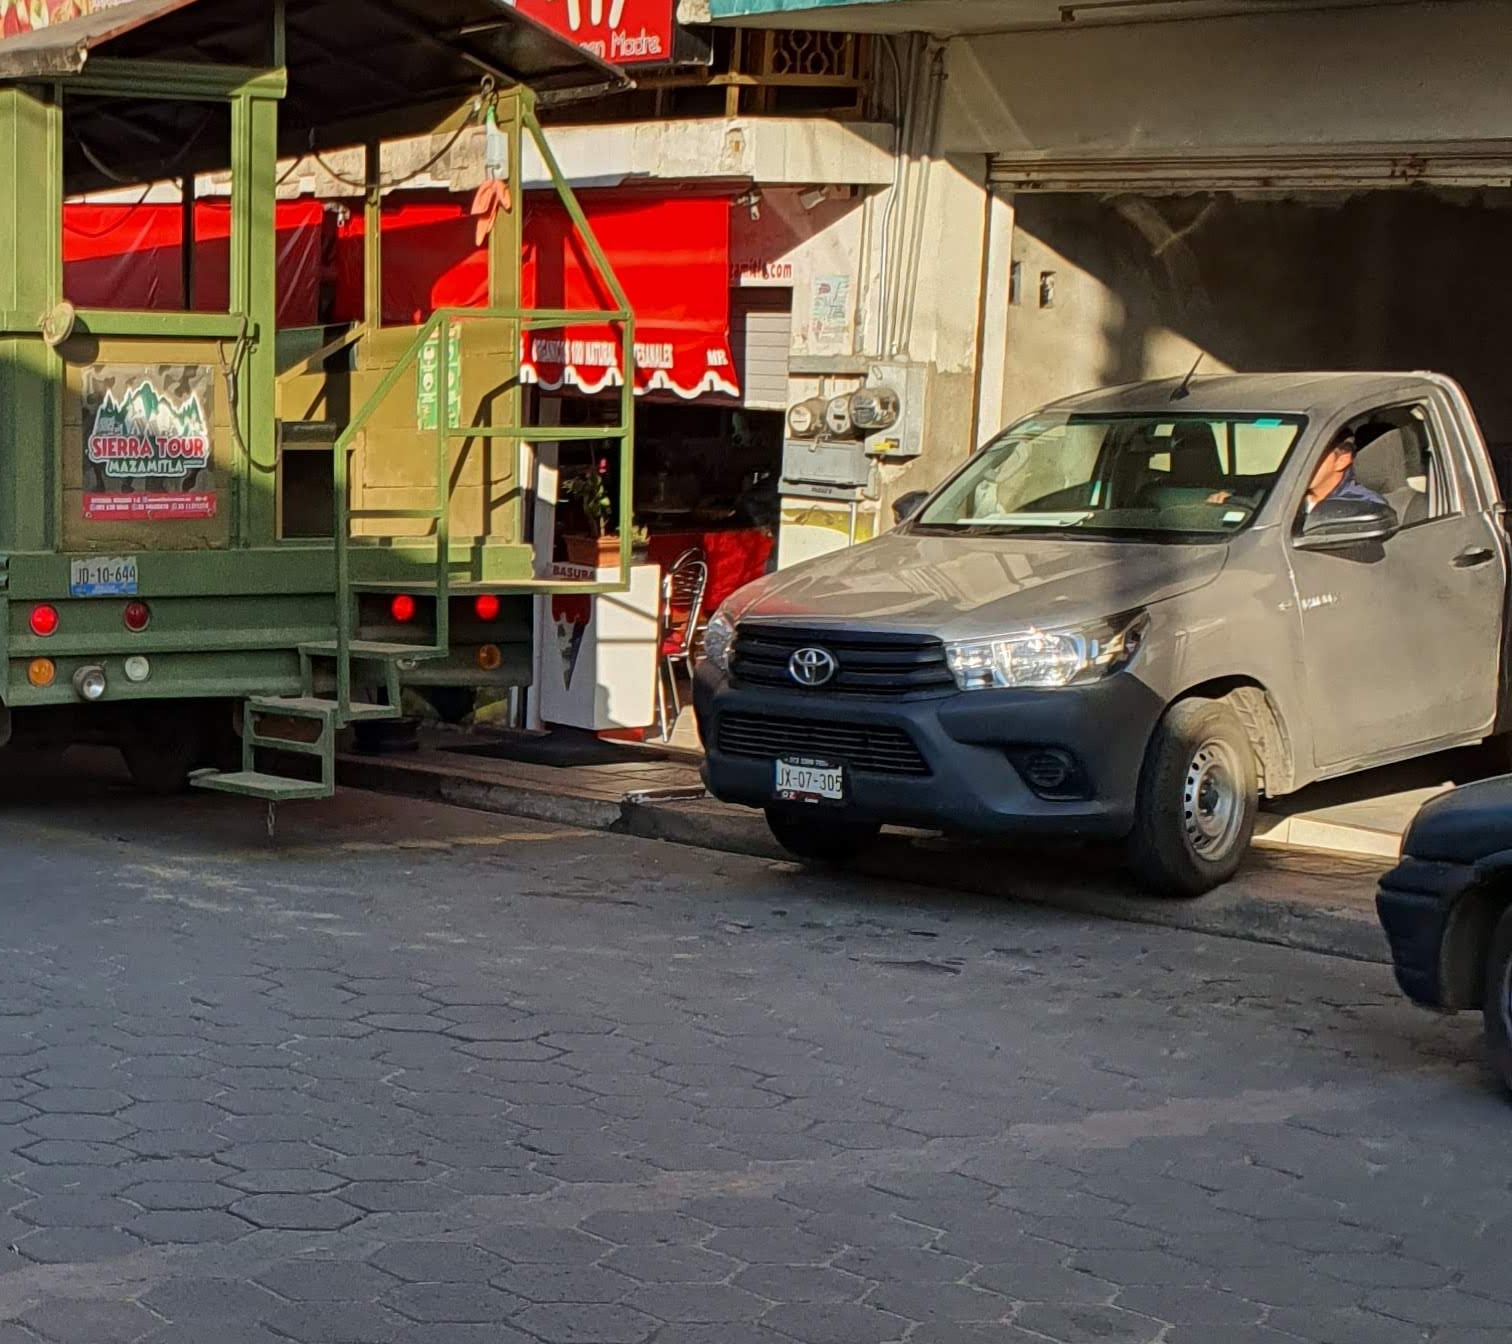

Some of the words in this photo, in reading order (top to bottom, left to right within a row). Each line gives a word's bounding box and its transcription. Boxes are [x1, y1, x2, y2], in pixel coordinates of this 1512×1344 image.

[92, 436, 153, 458] SIERRA
[156, 436, 204, 458] TOUR
[108, 459, 184, 474] MAZAMITLA
